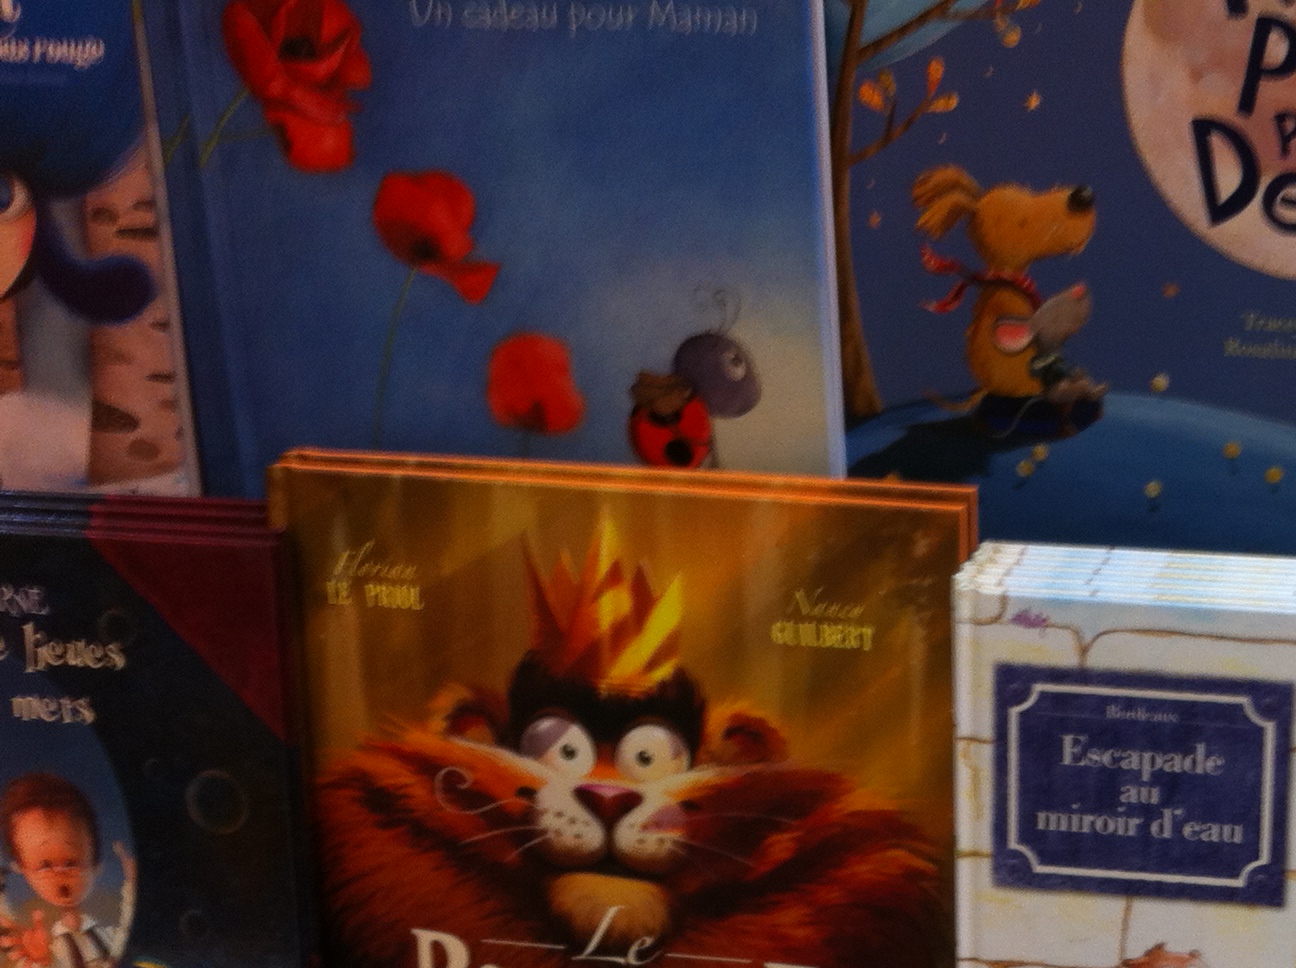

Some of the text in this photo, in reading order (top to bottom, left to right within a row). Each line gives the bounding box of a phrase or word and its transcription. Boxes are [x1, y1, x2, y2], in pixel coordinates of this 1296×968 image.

[461, 1, 558, 32] cadeau
[568, 2, 635, 38] pour
[647, 0, 758, 37] Maman
[1059, 733, 1227, 783] Escapade
[1119, 784, 1162, 806] au
[1035, 802, 1245, 846] miroir d'eau
[570, 905, 665, 966] Le
